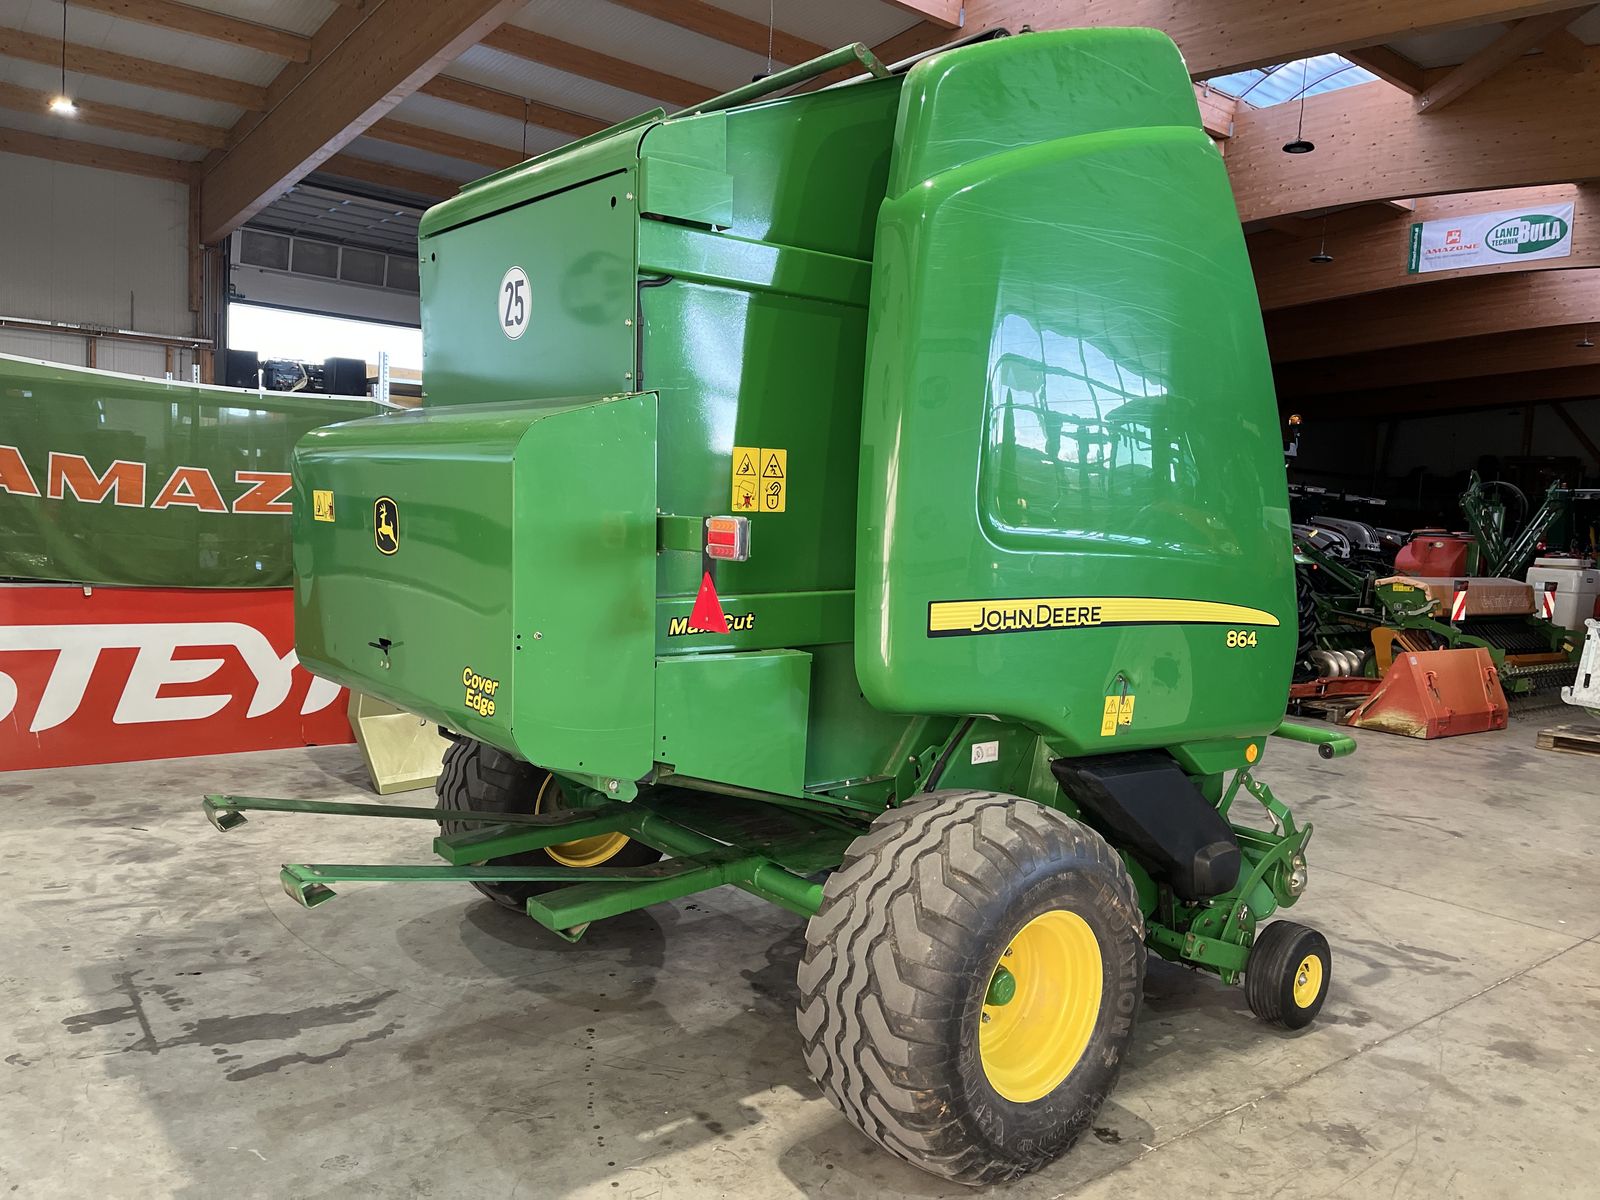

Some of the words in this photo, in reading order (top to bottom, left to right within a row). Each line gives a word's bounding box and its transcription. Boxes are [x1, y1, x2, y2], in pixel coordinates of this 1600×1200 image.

[1491, 237, 1519, 247] TECHNIK
[1495, 226, 1520, 238] LAND
[1519, 220, 1561, 244] BULLA
[1425, 243, 1480, 255] AMAZONE
[505, 280, 524, 326] 25
[972, 606, 1033, 629] JOHN
[1036, 604, 1102, 626] DEERE
[1226, 629, 1258, 648] 864
[462, 666, 499, 696] Cover
[465, 687, 496, 717] Edge
